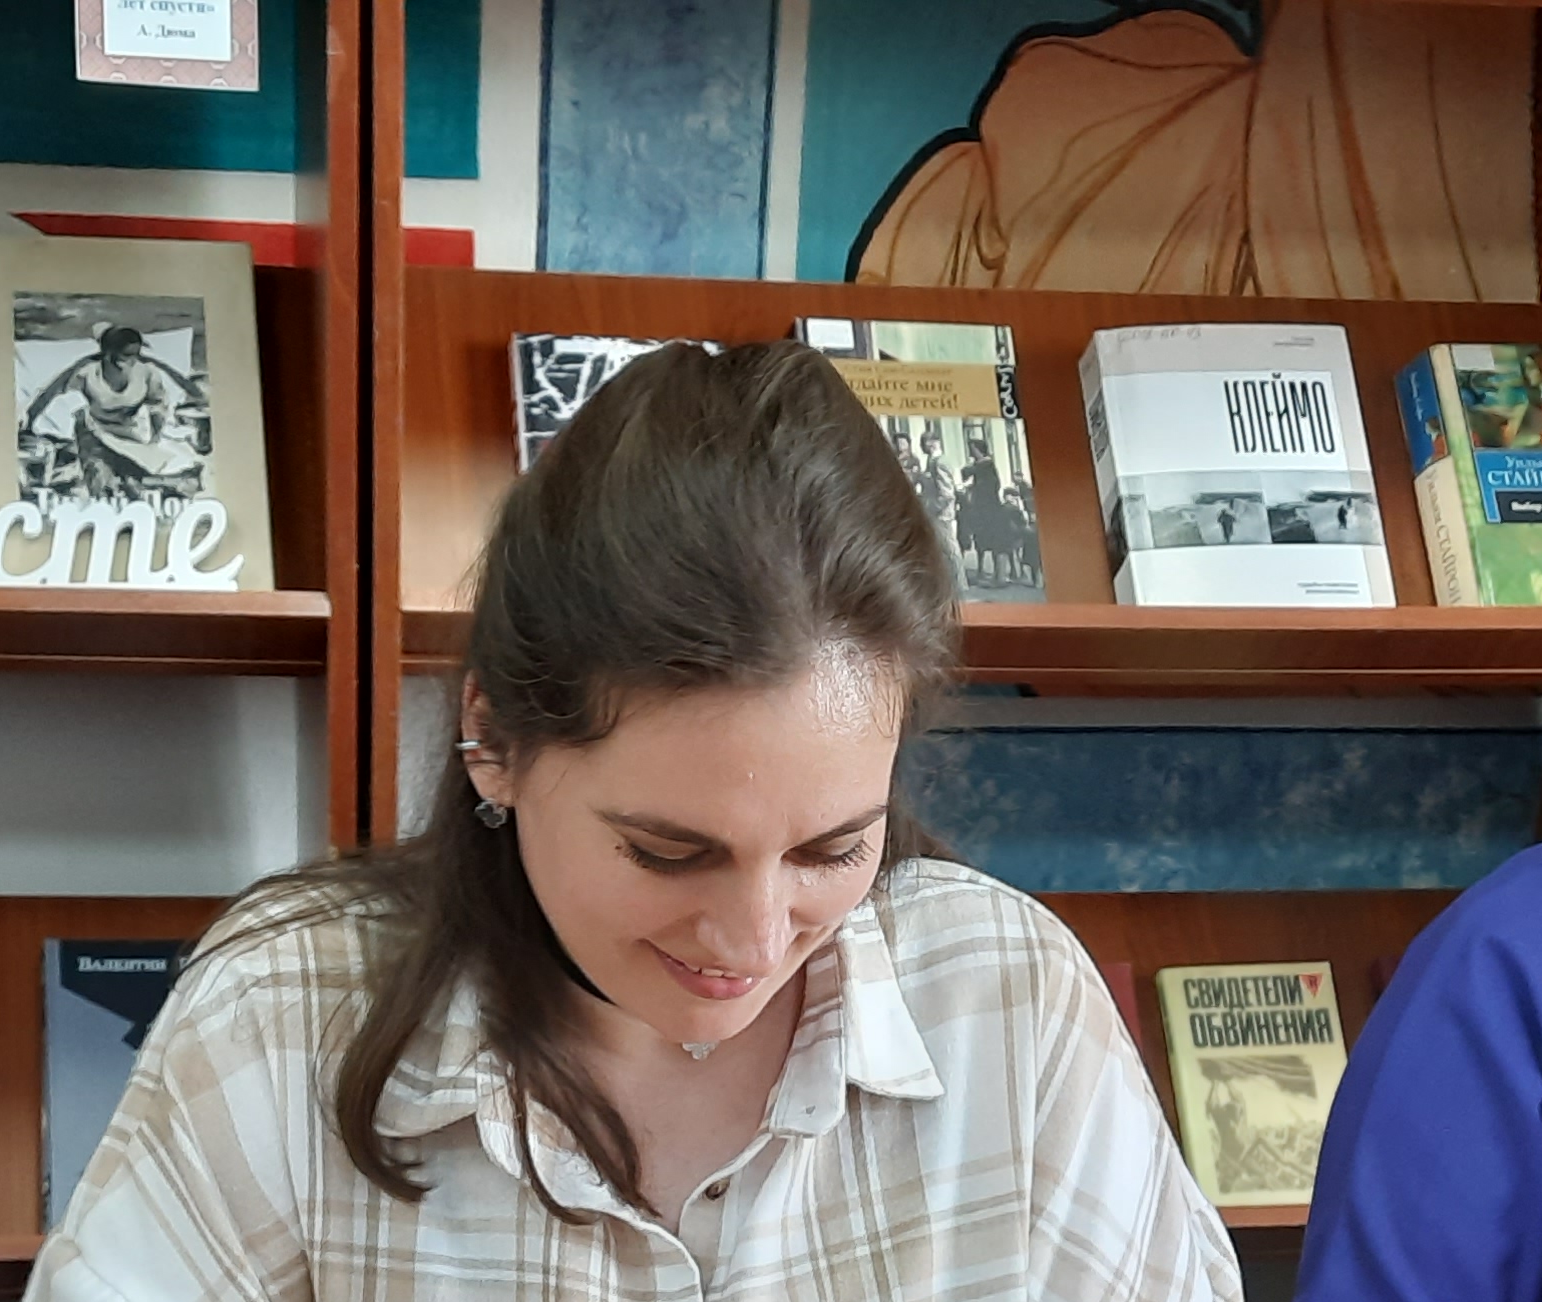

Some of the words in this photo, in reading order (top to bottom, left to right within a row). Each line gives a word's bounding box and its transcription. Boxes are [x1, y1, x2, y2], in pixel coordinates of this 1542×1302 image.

[136, 24, 152, 37] А.
[155, 25, 196, 39] Дюма
[915, 380, 953, 392] мне
[899, 393, 958, 410] детей!
[1223, 372, 1336, 455] КЛЕЙМО
[1183, 974, 1303, 1009] СВИДЕТЕЛИ
[1189, 1007, 1334, 1048] ОБВИНЕНИЯ
